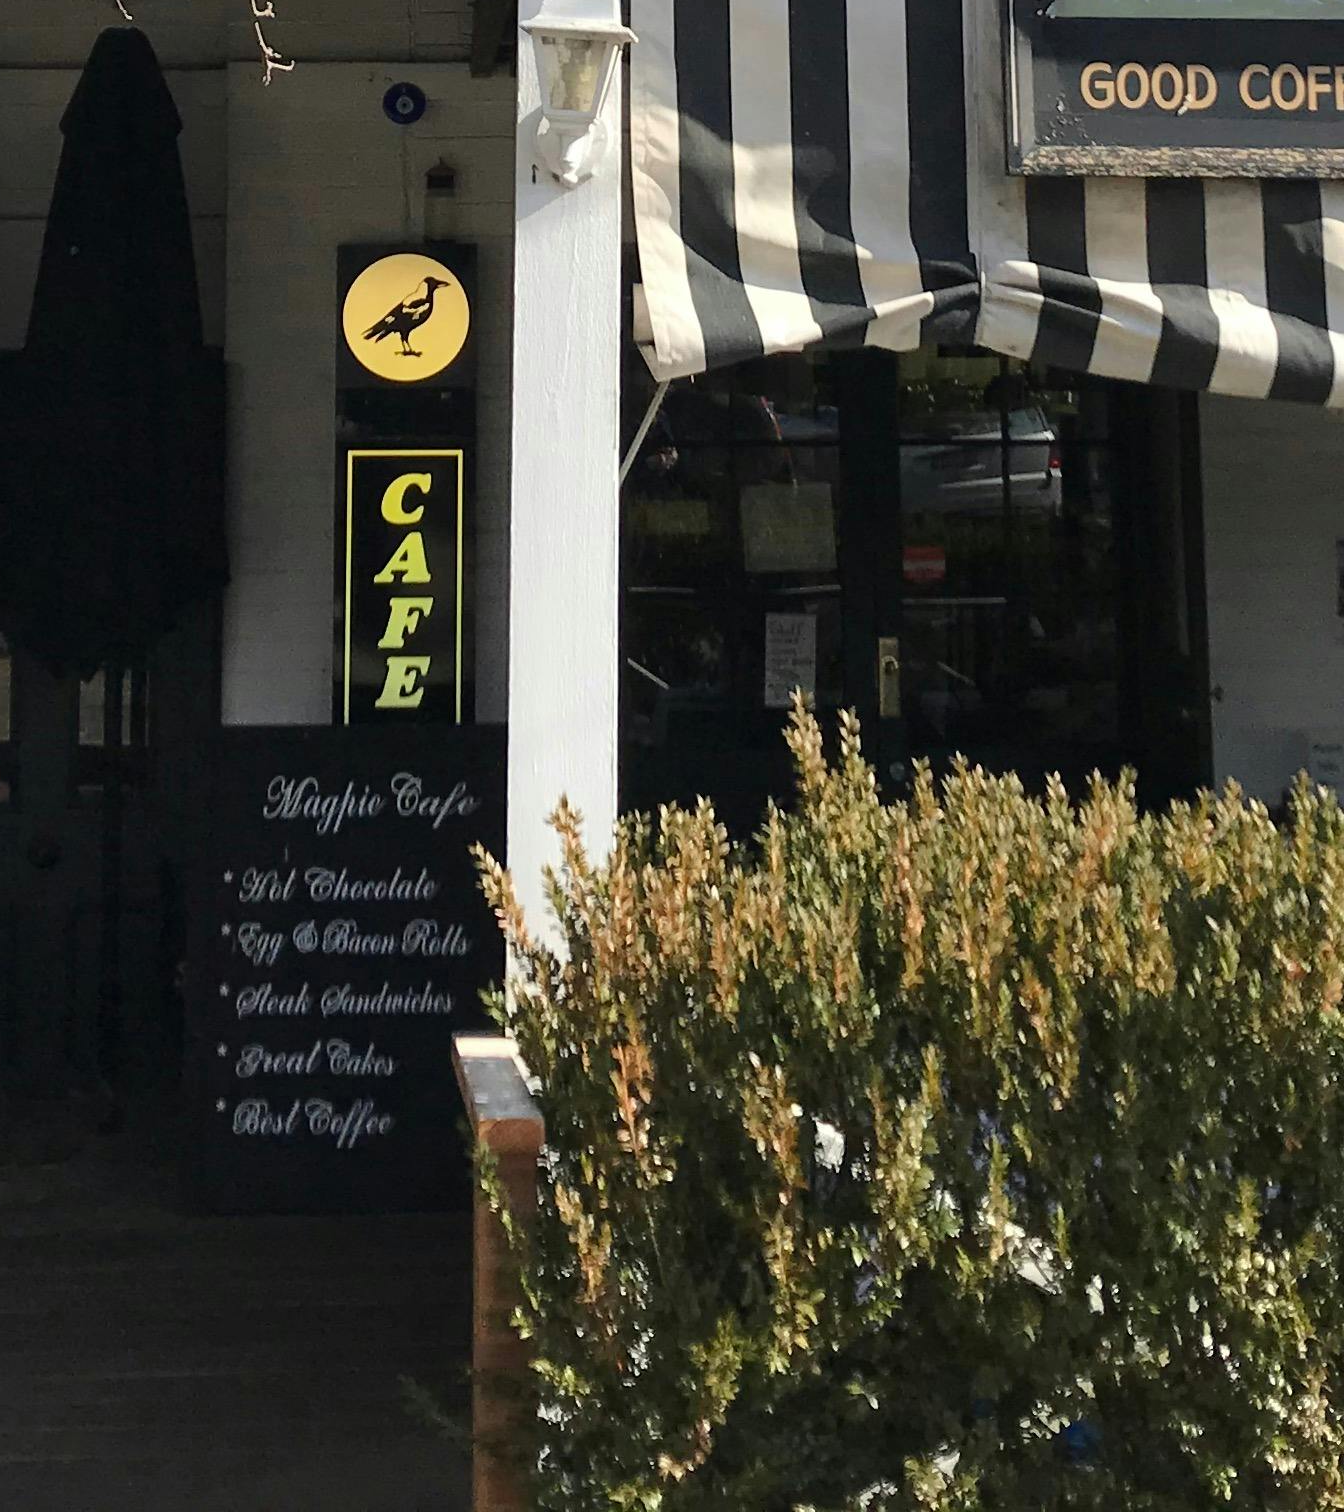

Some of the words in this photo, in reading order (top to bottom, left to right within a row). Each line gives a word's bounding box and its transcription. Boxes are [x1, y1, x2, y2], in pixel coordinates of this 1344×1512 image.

[1080, 62, 1217, 113] GOOD
[374, 472, 433, 708] CAFE
[263, 775, 384, 835] Magpie
[391, 772, 481, 830] Cafe
[239, 867, 298, 903] Hot
[304, 866, 438, 902] Chocolate
[238, 921, 284, 966] Egg
[293, 919, 318, 954] &
[322, 919, 396, 955] Bacon
[401, 918, 472, 956] Rolls
[236, 982, 312, 1019] Steak
[321, 981, 454, 1018] Sandwiches
[235, 1040, 322, 1078] Great
[327, 1039, 398, 1076] Cakes
[233, 1099, 301, 1136] Best
[305, 1098, 395, 1150] Coffee
